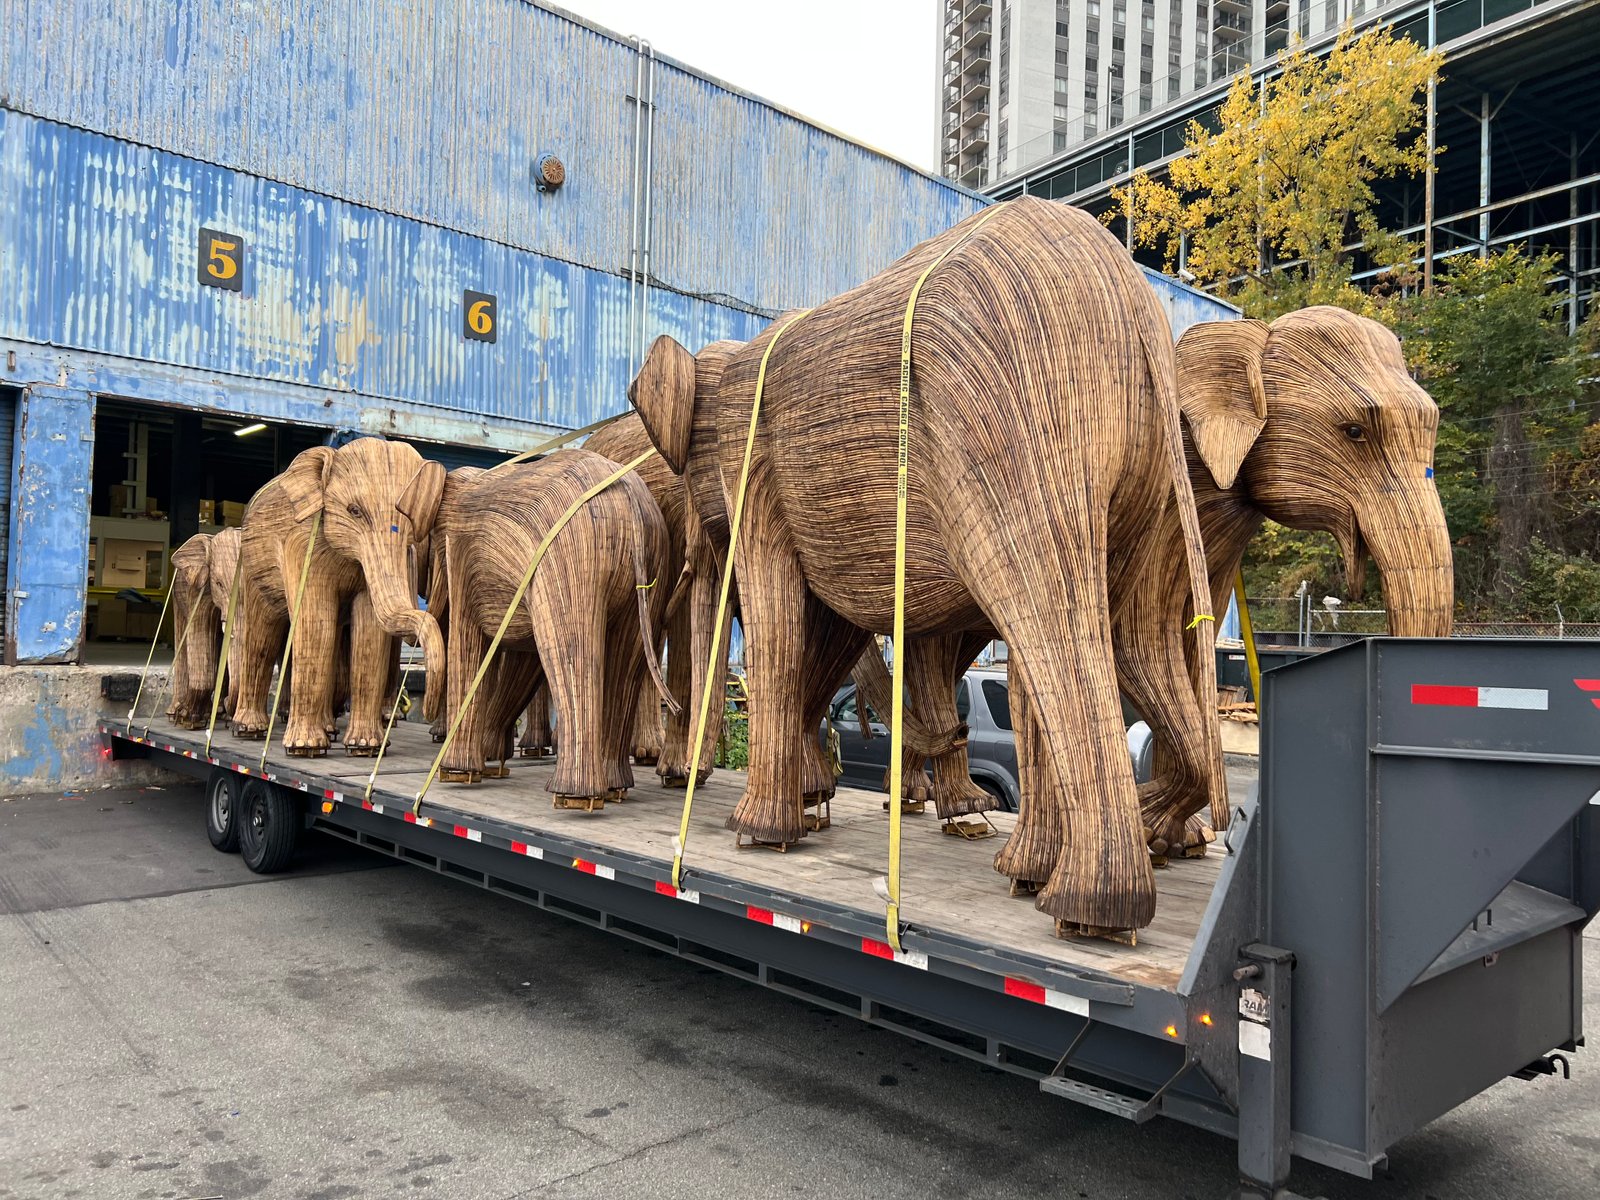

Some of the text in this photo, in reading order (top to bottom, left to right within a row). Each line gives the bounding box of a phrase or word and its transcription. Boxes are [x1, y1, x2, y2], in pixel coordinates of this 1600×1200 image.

[207, 238, 237, 280] 5
[468, 300, 493, 334] 6
[899, 429, 907, 467] CONTROL
